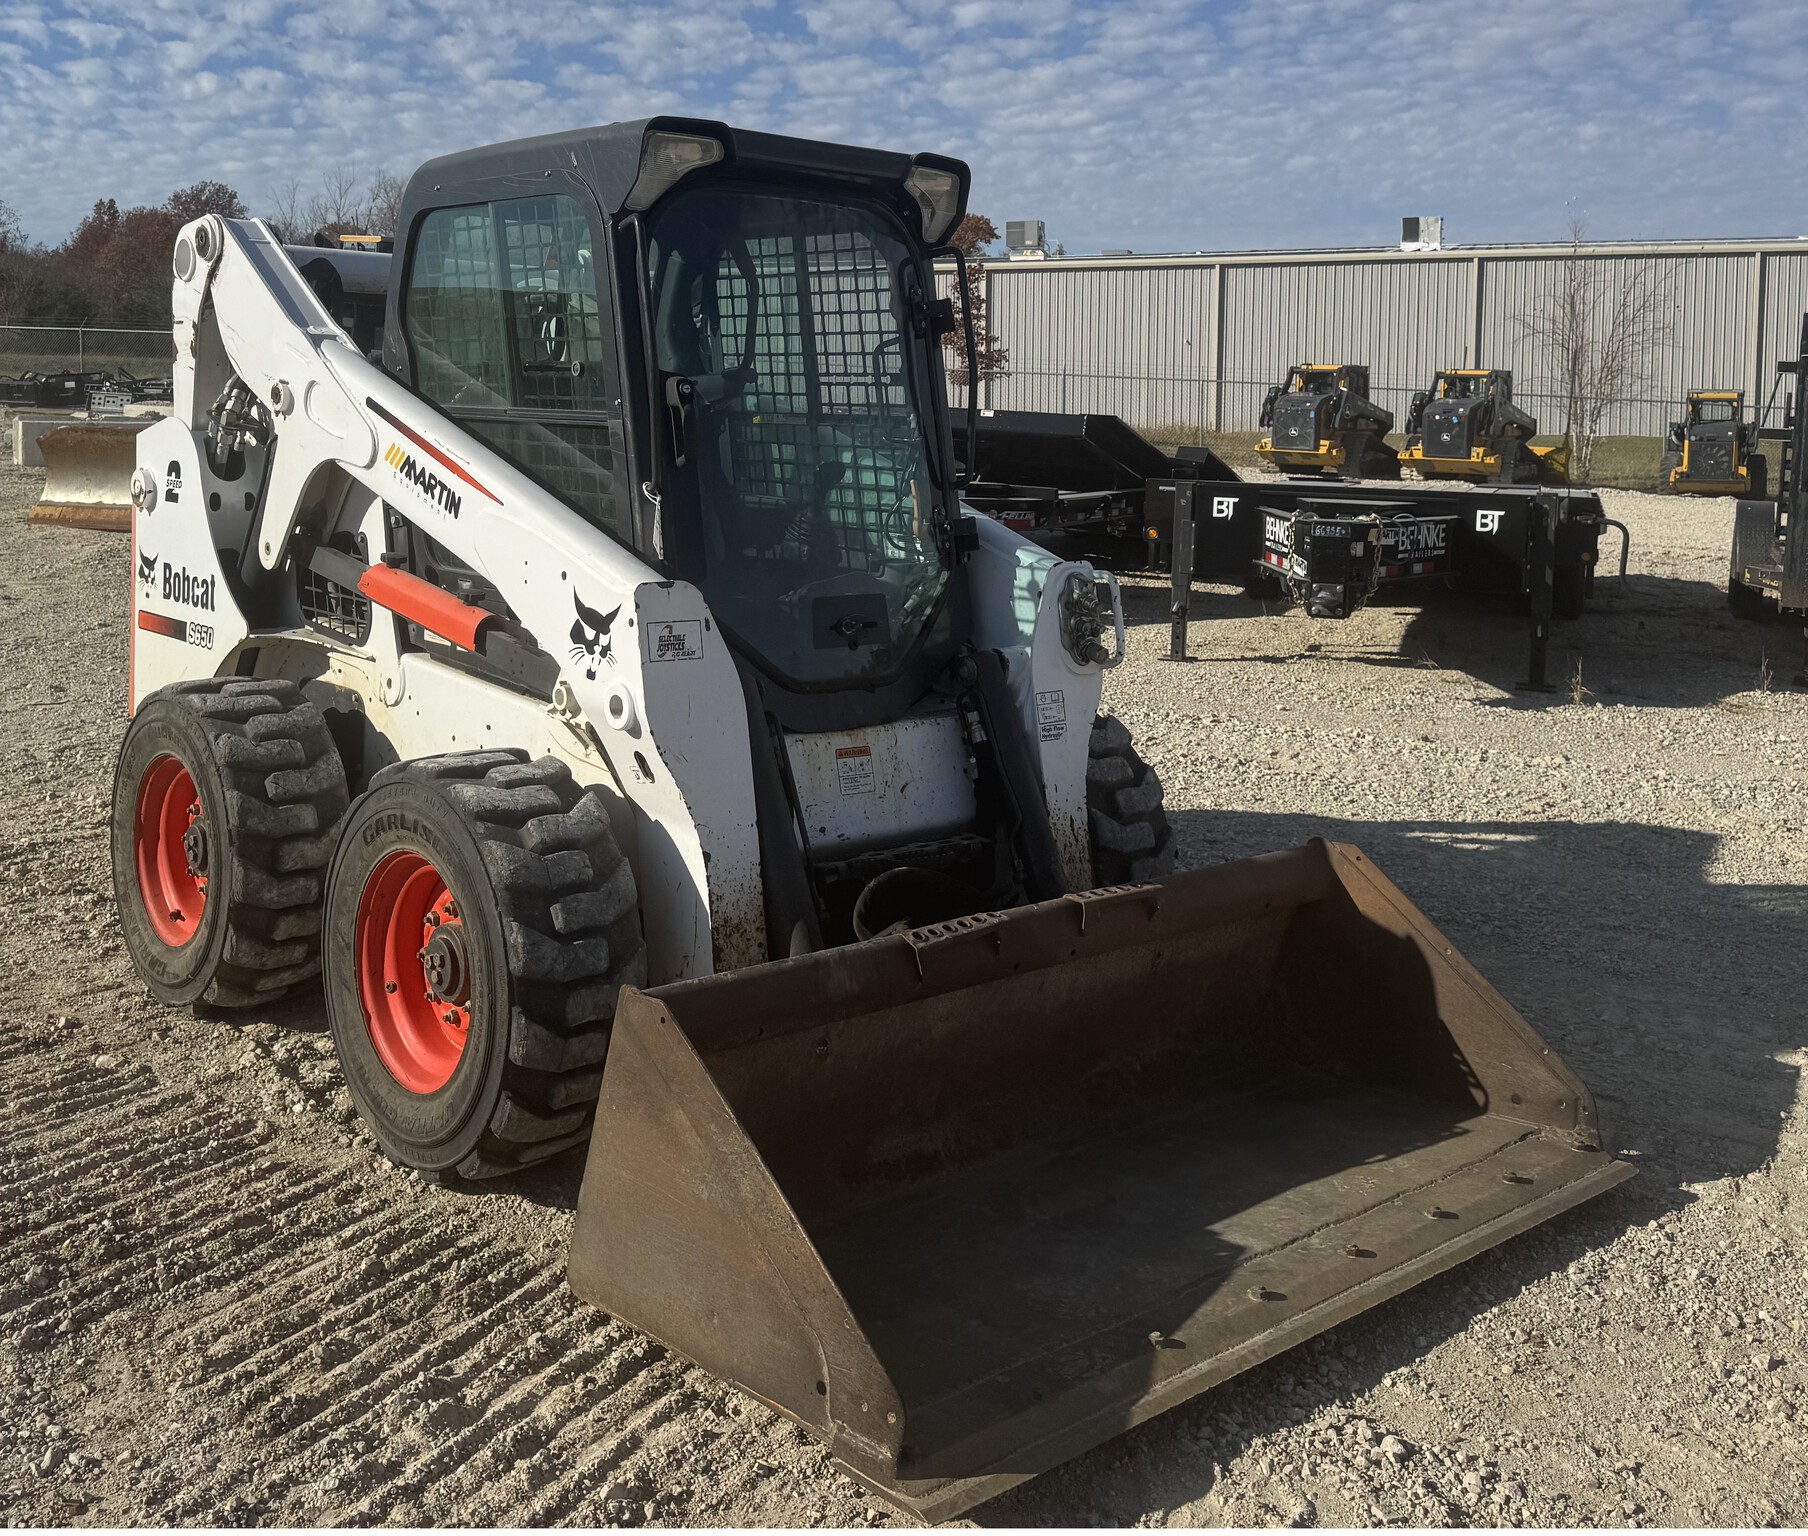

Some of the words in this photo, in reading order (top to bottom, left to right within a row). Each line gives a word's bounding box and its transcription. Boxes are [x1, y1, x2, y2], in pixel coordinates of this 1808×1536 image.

[166, 478, 182, 489] SPEED
[399, 454, 462, 520] MARTIN
[1212, 496, 1239, 520] BT
[1475, 509, 1506, 535] BT
[162, 562, 216, 612] Bobcat
[188, 621, 215, 650] S650
